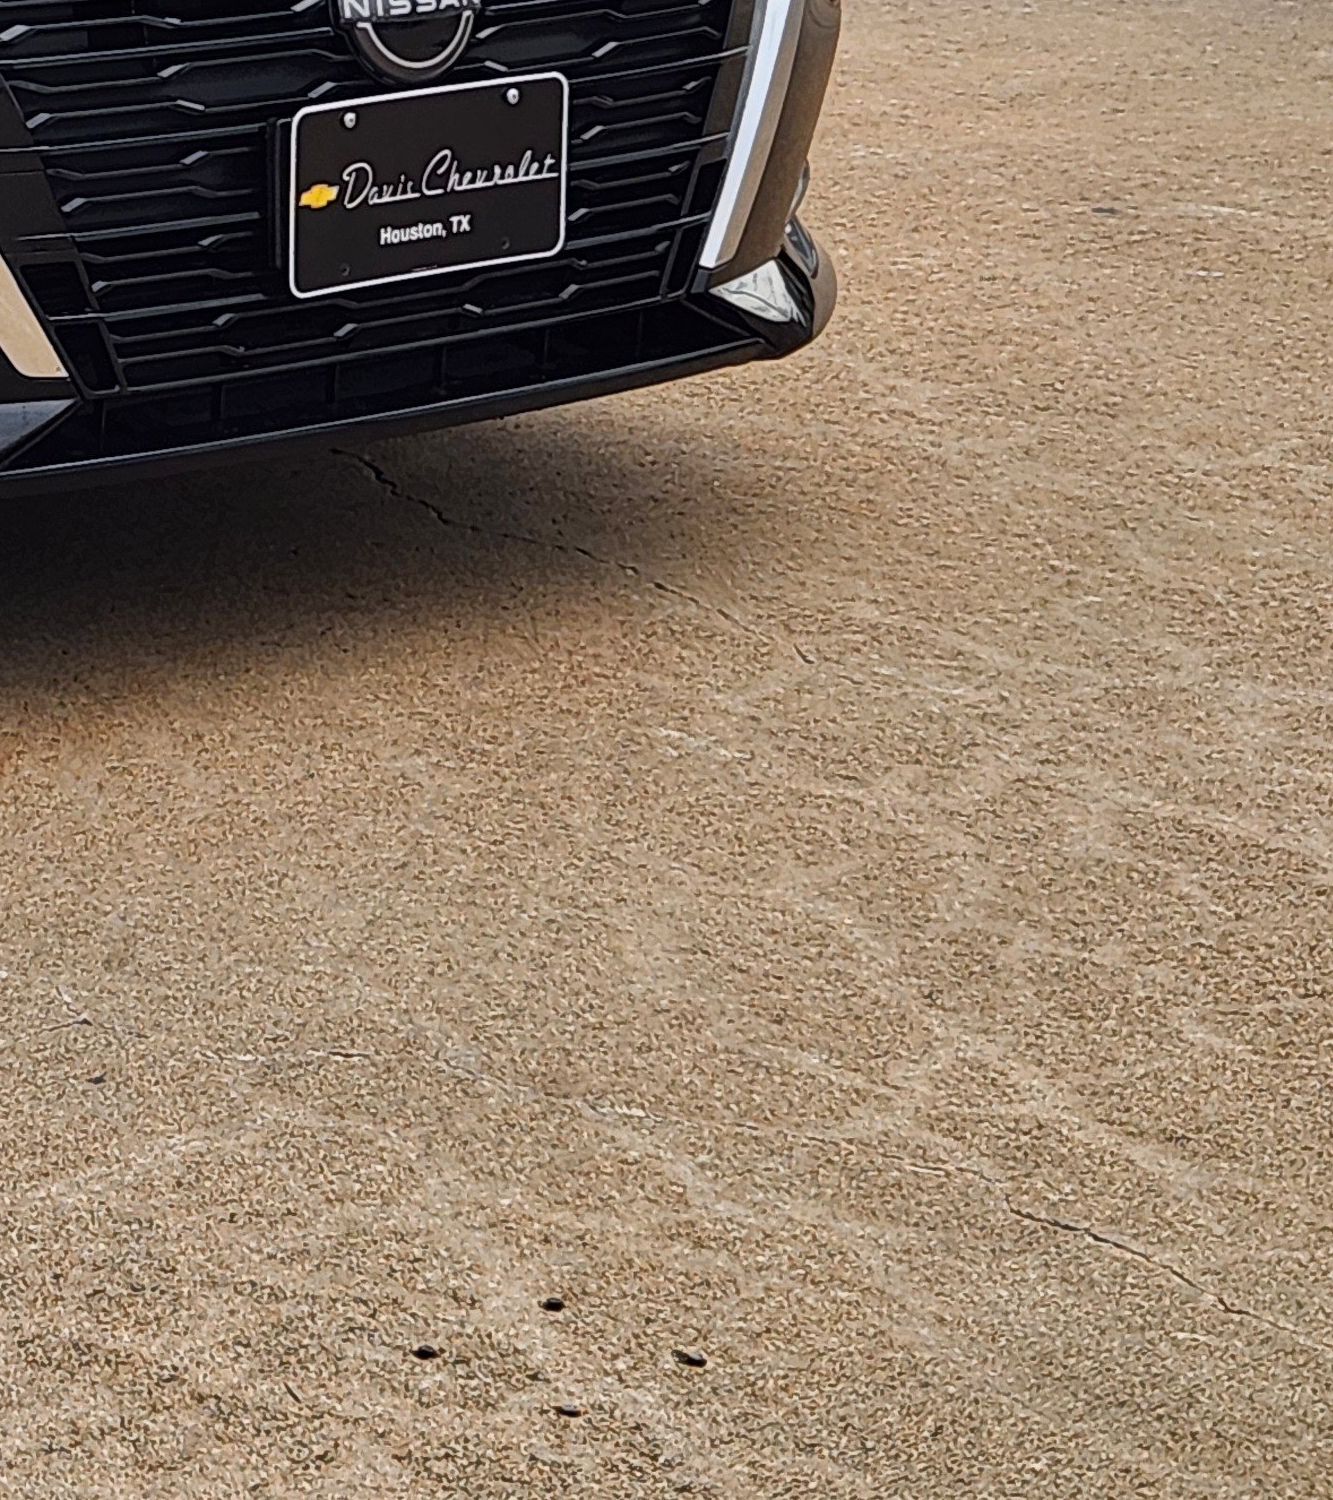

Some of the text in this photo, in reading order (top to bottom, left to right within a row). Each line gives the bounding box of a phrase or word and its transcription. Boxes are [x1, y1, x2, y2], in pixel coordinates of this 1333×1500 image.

[343, 149, 559, 209] Davis Chevrolet
[380, 214, 471, 245] Houston, TX
